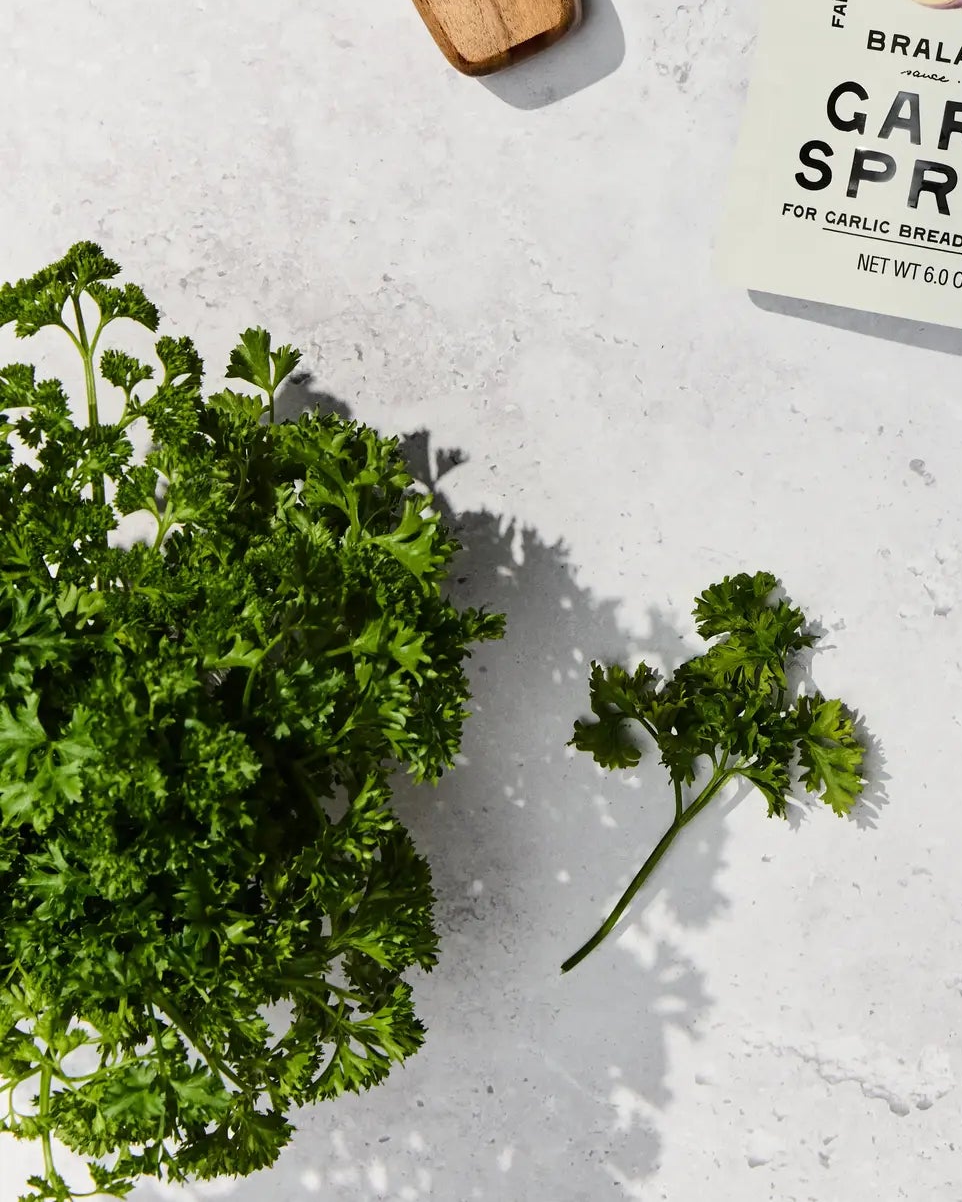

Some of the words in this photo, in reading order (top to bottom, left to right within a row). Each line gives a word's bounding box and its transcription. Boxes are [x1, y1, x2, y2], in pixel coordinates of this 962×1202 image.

[900, 68, 950, 84] sauce
[781, 202, 818, 222] FOR
[824, 210, 890, 234] GARLIC
[856, 253, 891, 275] NET
[894, 259, 922, 281] WT
[923, 265, 949, 286] 6.0
